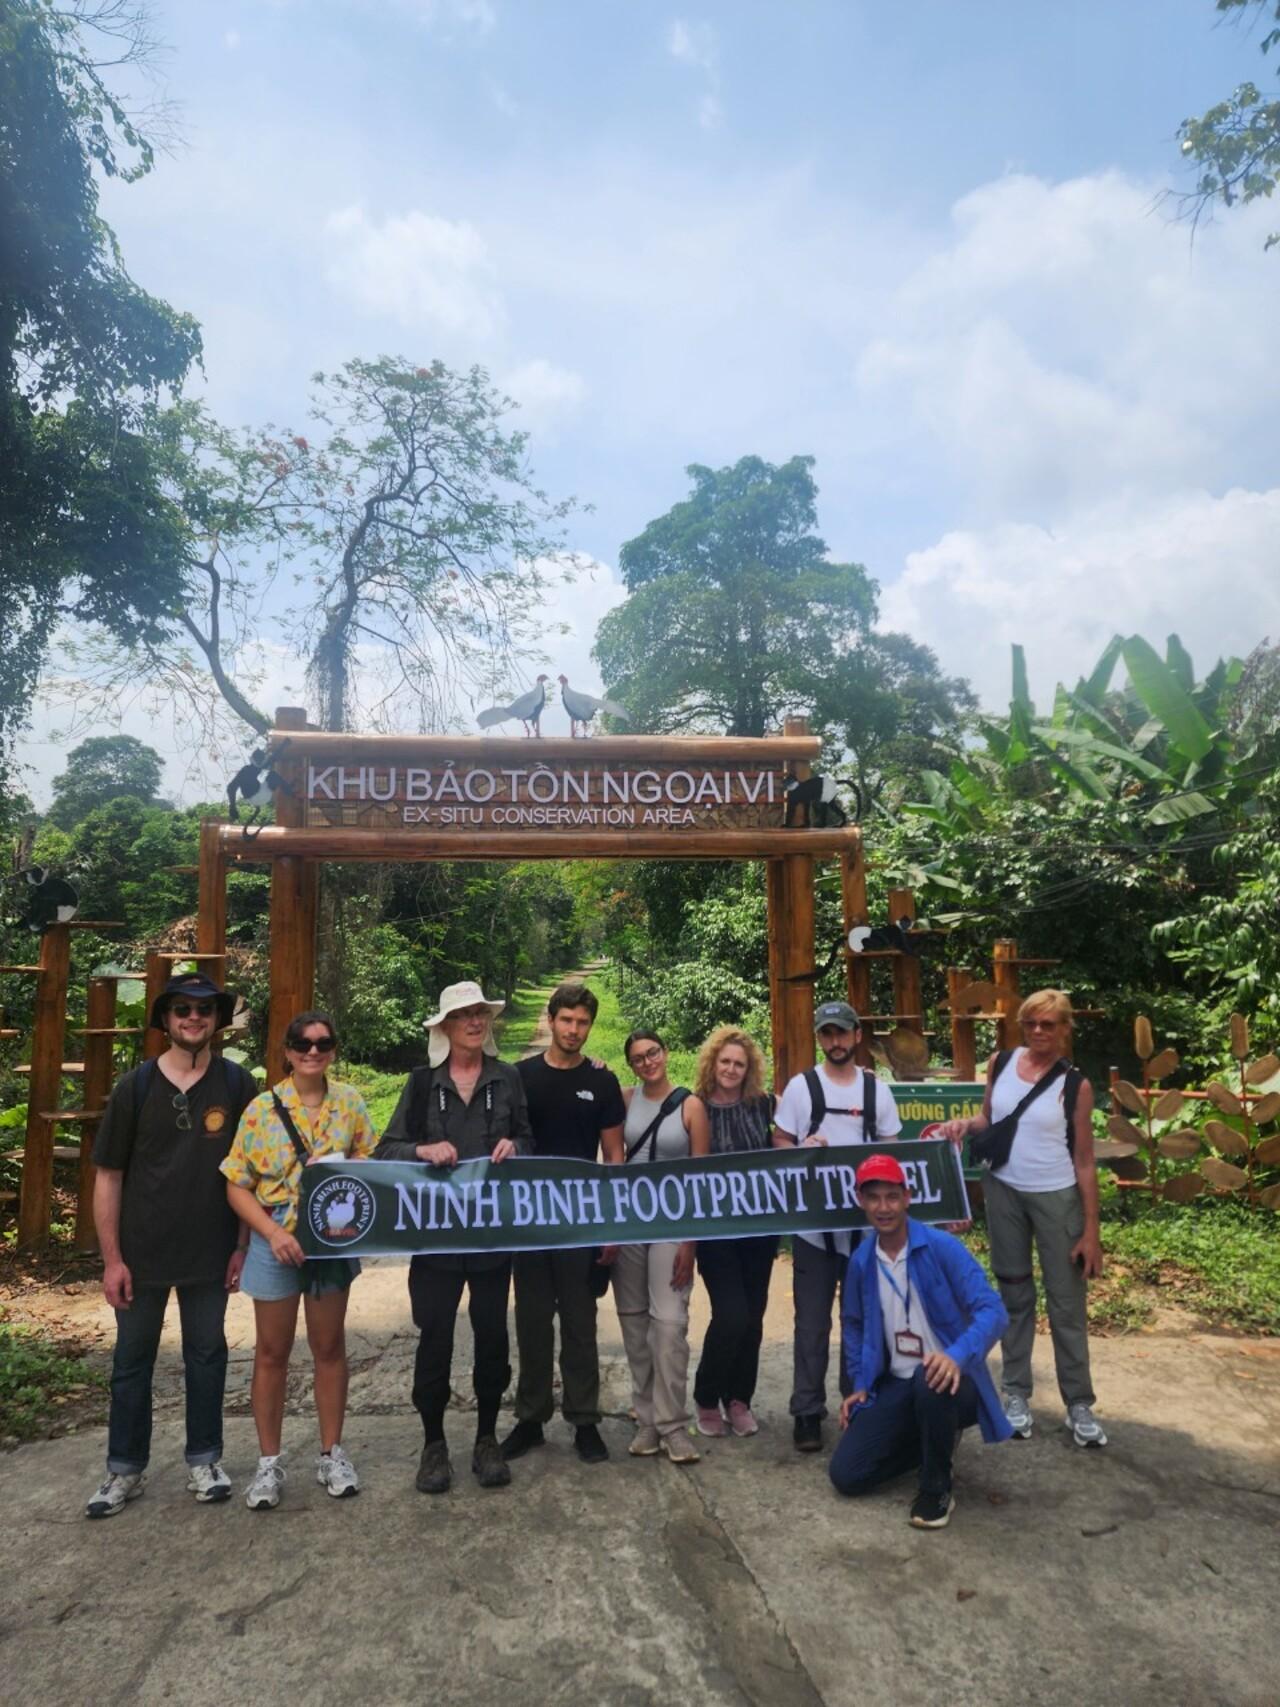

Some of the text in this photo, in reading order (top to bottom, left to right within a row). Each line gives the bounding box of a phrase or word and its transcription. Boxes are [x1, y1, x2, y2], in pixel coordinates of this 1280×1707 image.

[308, 760, 774, 810] KHU BẢO TỒN NGOẠI VI
[403, 806, 696, 825] EX-SITU CONSERVATION AREA
[895, 1099, 945, 1121] ƯỜNG
[393, 1161, 942, 1231] NINH BINH FOOTPRINT TREL
